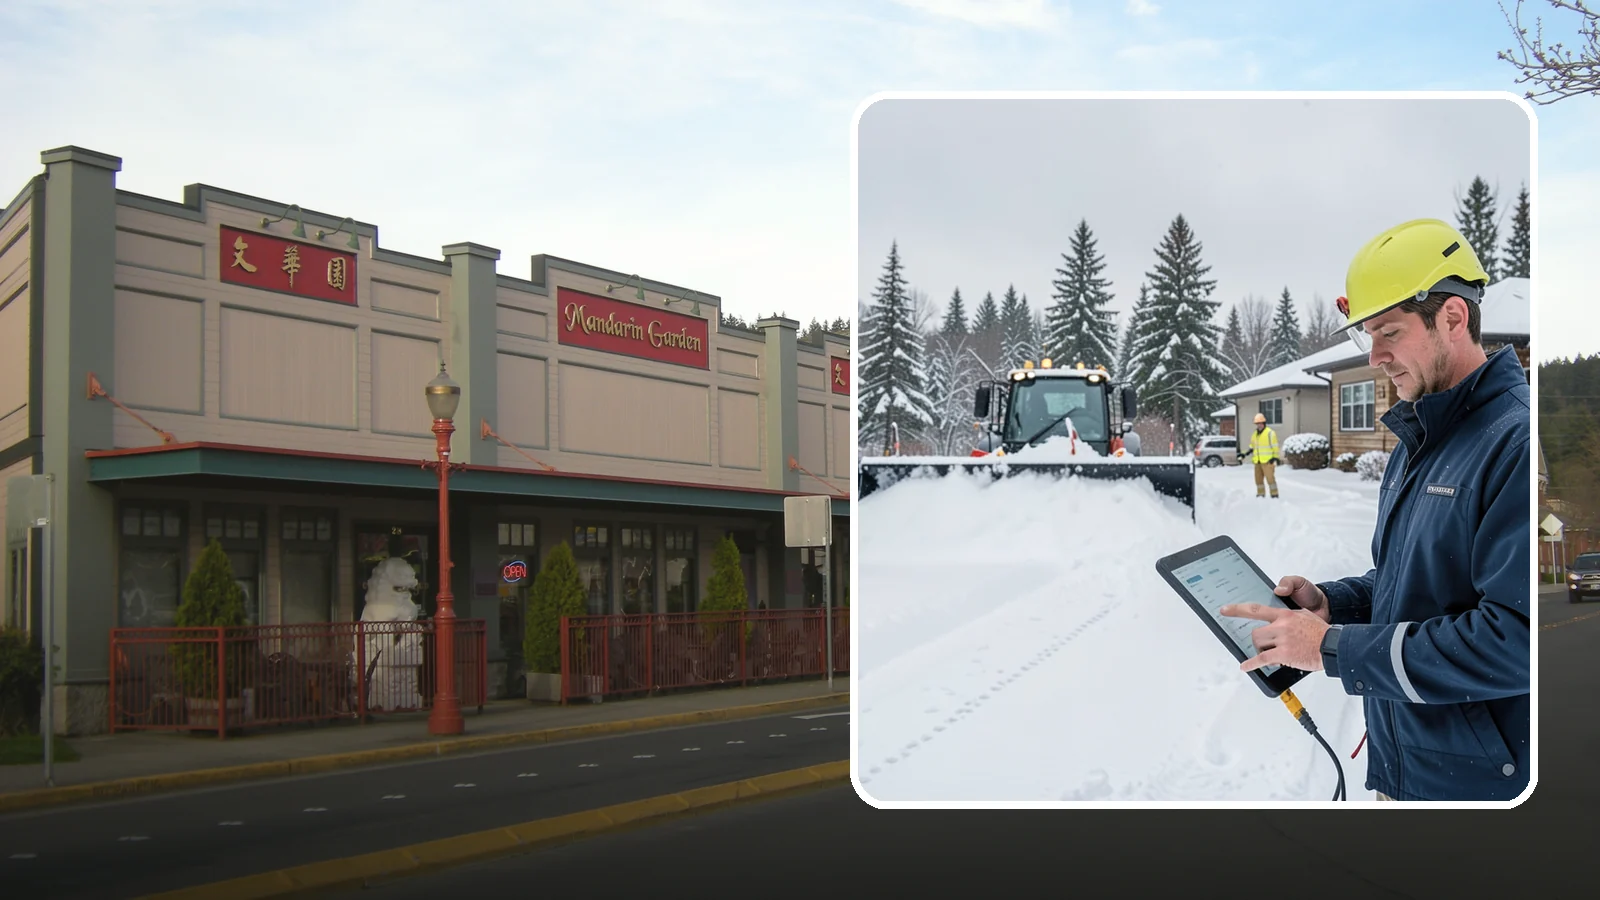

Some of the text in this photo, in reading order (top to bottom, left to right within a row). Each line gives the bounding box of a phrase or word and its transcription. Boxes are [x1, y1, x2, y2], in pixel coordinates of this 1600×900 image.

[230, 236, 346, 291] 文華園
[564, 302, 701, 352] Mandarin Garden
[503, 565, 527, 578] OPEN
